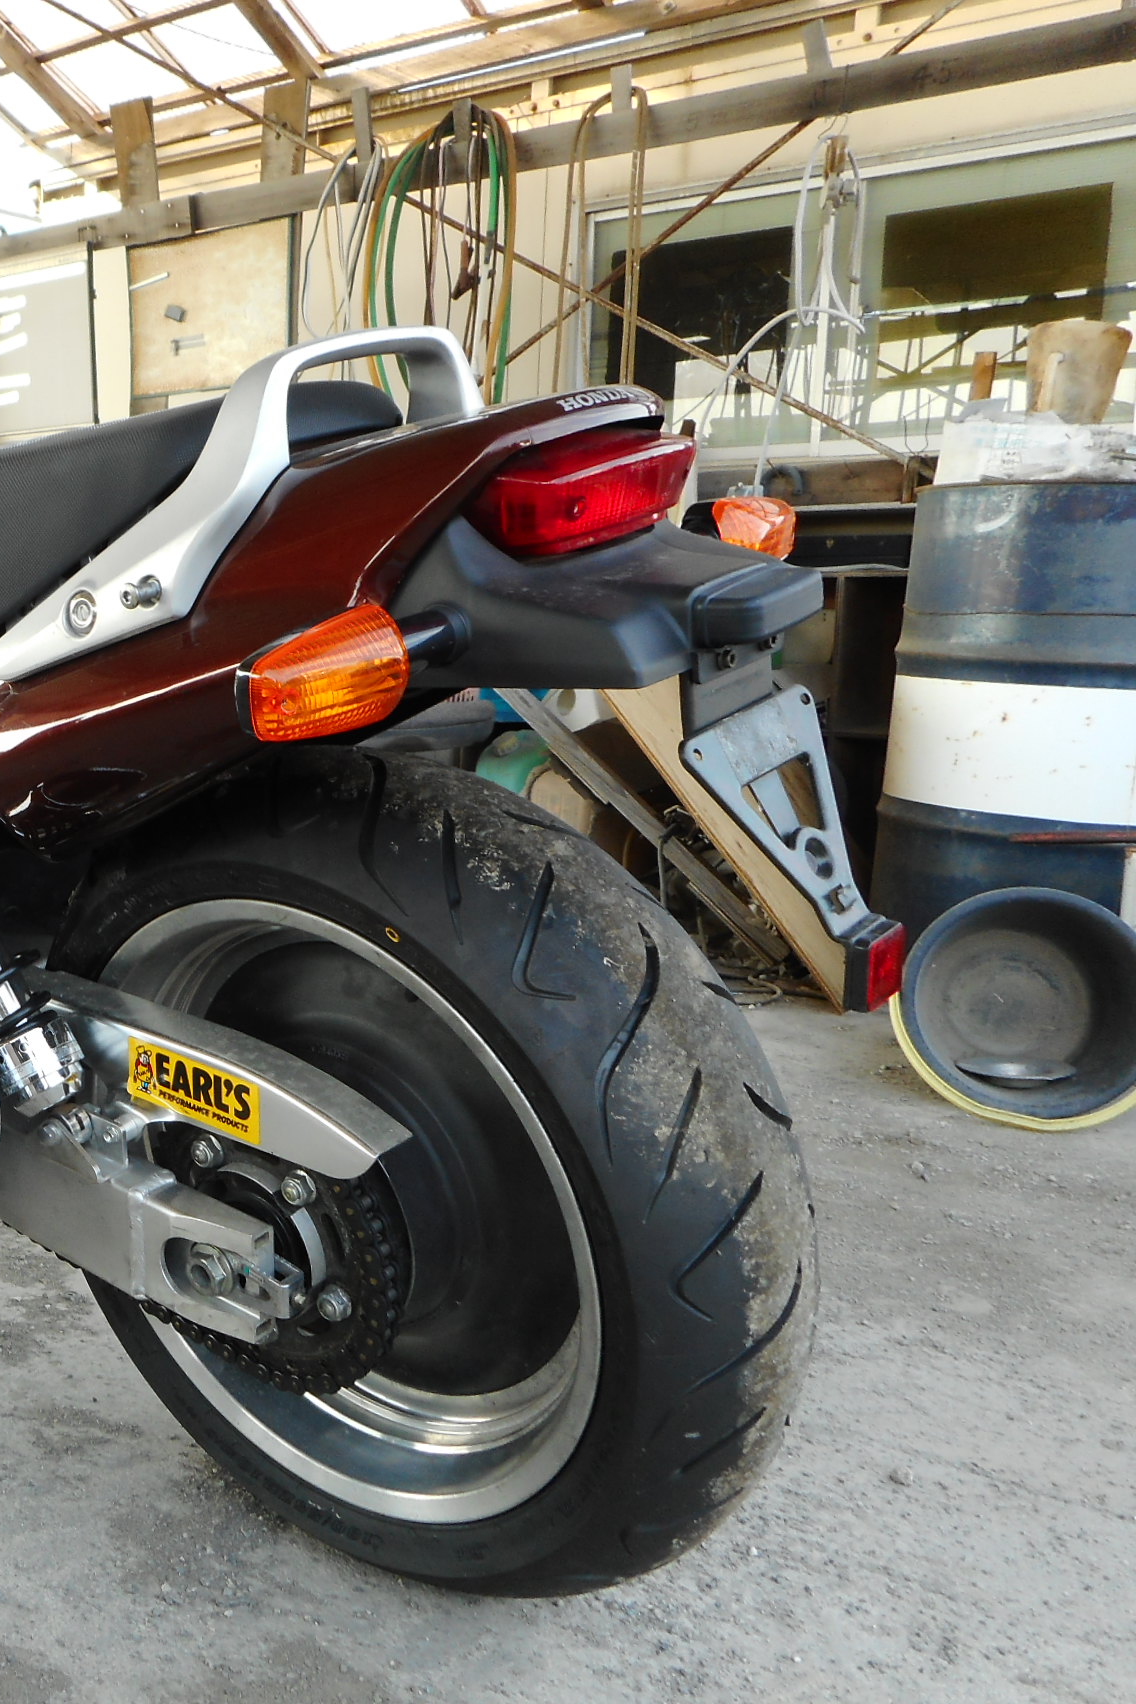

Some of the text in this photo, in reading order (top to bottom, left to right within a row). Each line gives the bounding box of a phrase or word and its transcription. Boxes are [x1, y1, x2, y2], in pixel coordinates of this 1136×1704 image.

[556, 387, 635, 412] HONDA
[155, 1052, 251, 1120] EARL'S
[158, 1089, 249, 1132] PERFORMANCE PRODUCTS
